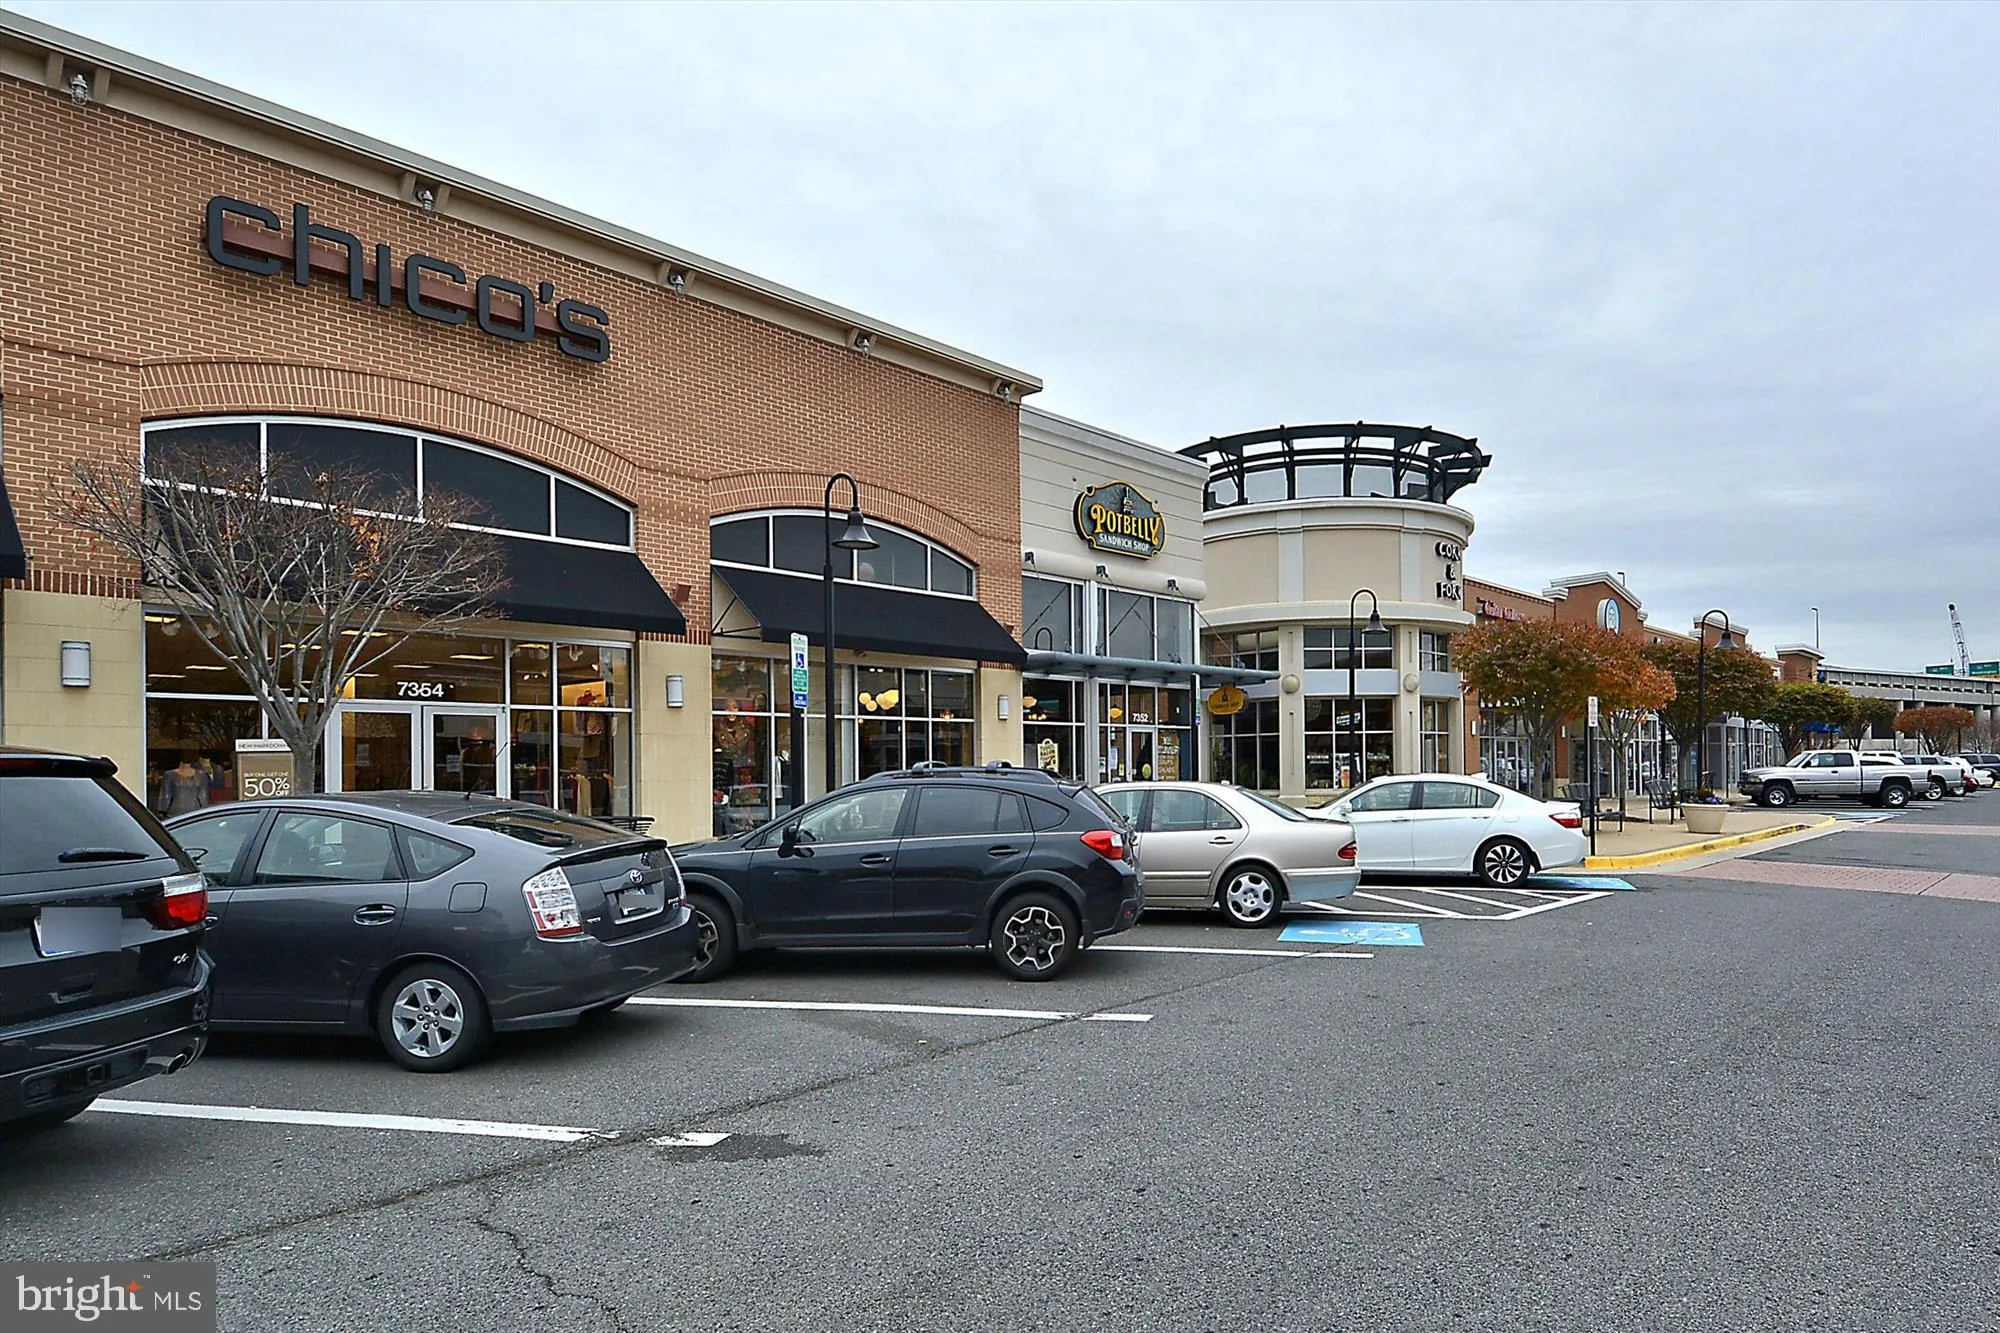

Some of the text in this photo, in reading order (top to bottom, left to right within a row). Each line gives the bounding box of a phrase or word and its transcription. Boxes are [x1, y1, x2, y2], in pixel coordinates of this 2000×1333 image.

[206, 195, 611, 364] chico's
[1091, 503, 1161, 546] POTBELLY
[1099, 533, 1150, 552] SANDWICH SHOP
[1446, 563, 1456, 580] &
[397, 681, 445, 698] 7354
[1132, 713, 1149, 723] 7352
[243, 777, 290, 797] 50%
